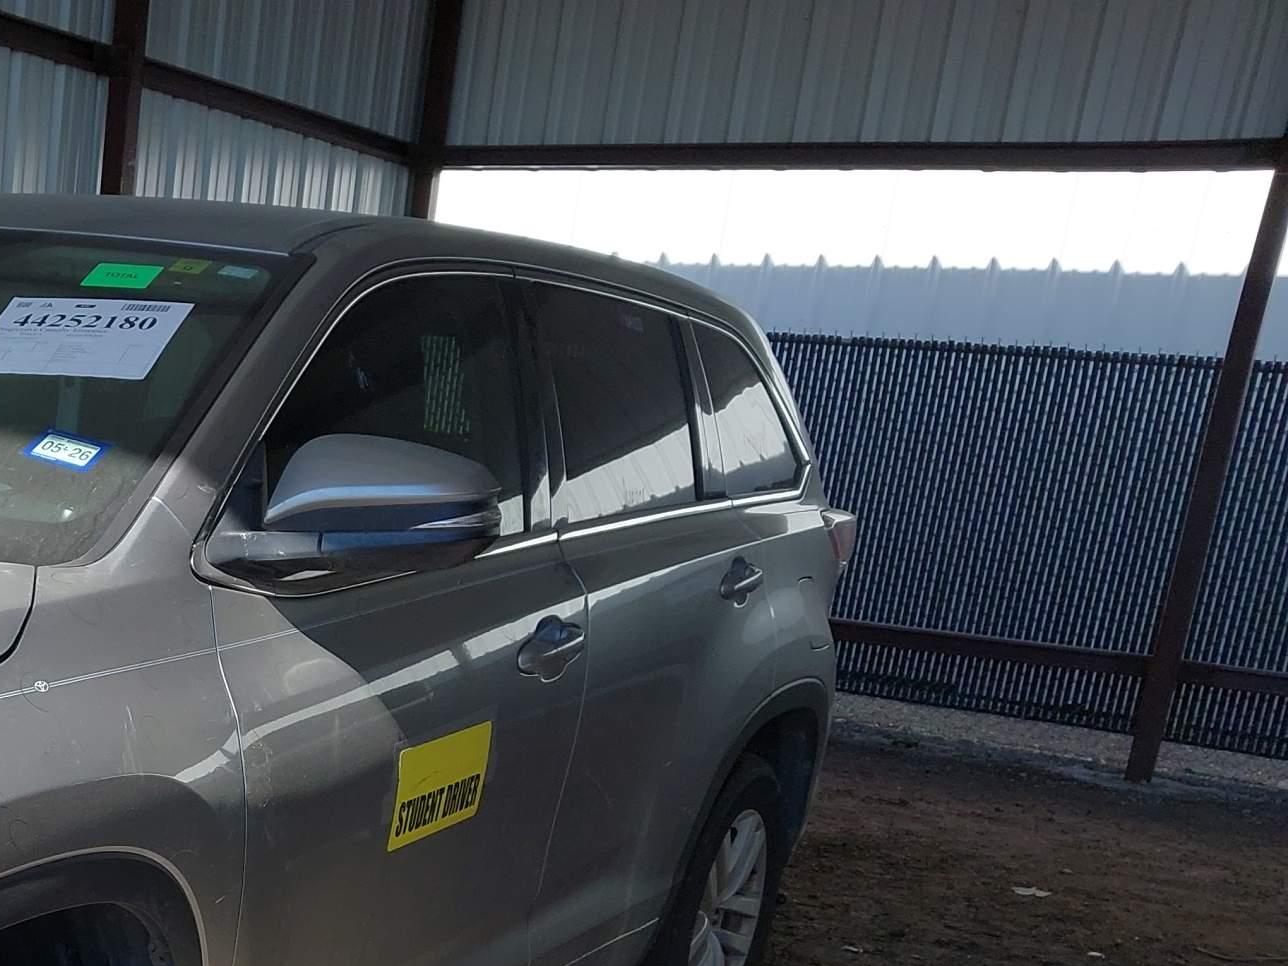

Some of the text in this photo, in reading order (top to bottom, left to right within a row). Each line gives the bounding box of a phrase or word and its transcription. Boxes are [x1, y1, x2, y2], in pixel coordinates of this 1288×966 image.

[13, 313, 158, 331] 44252180
[41, 440, 92, 461] 05 26
[395, 773, 481, 837] STUDENT DRIVER
